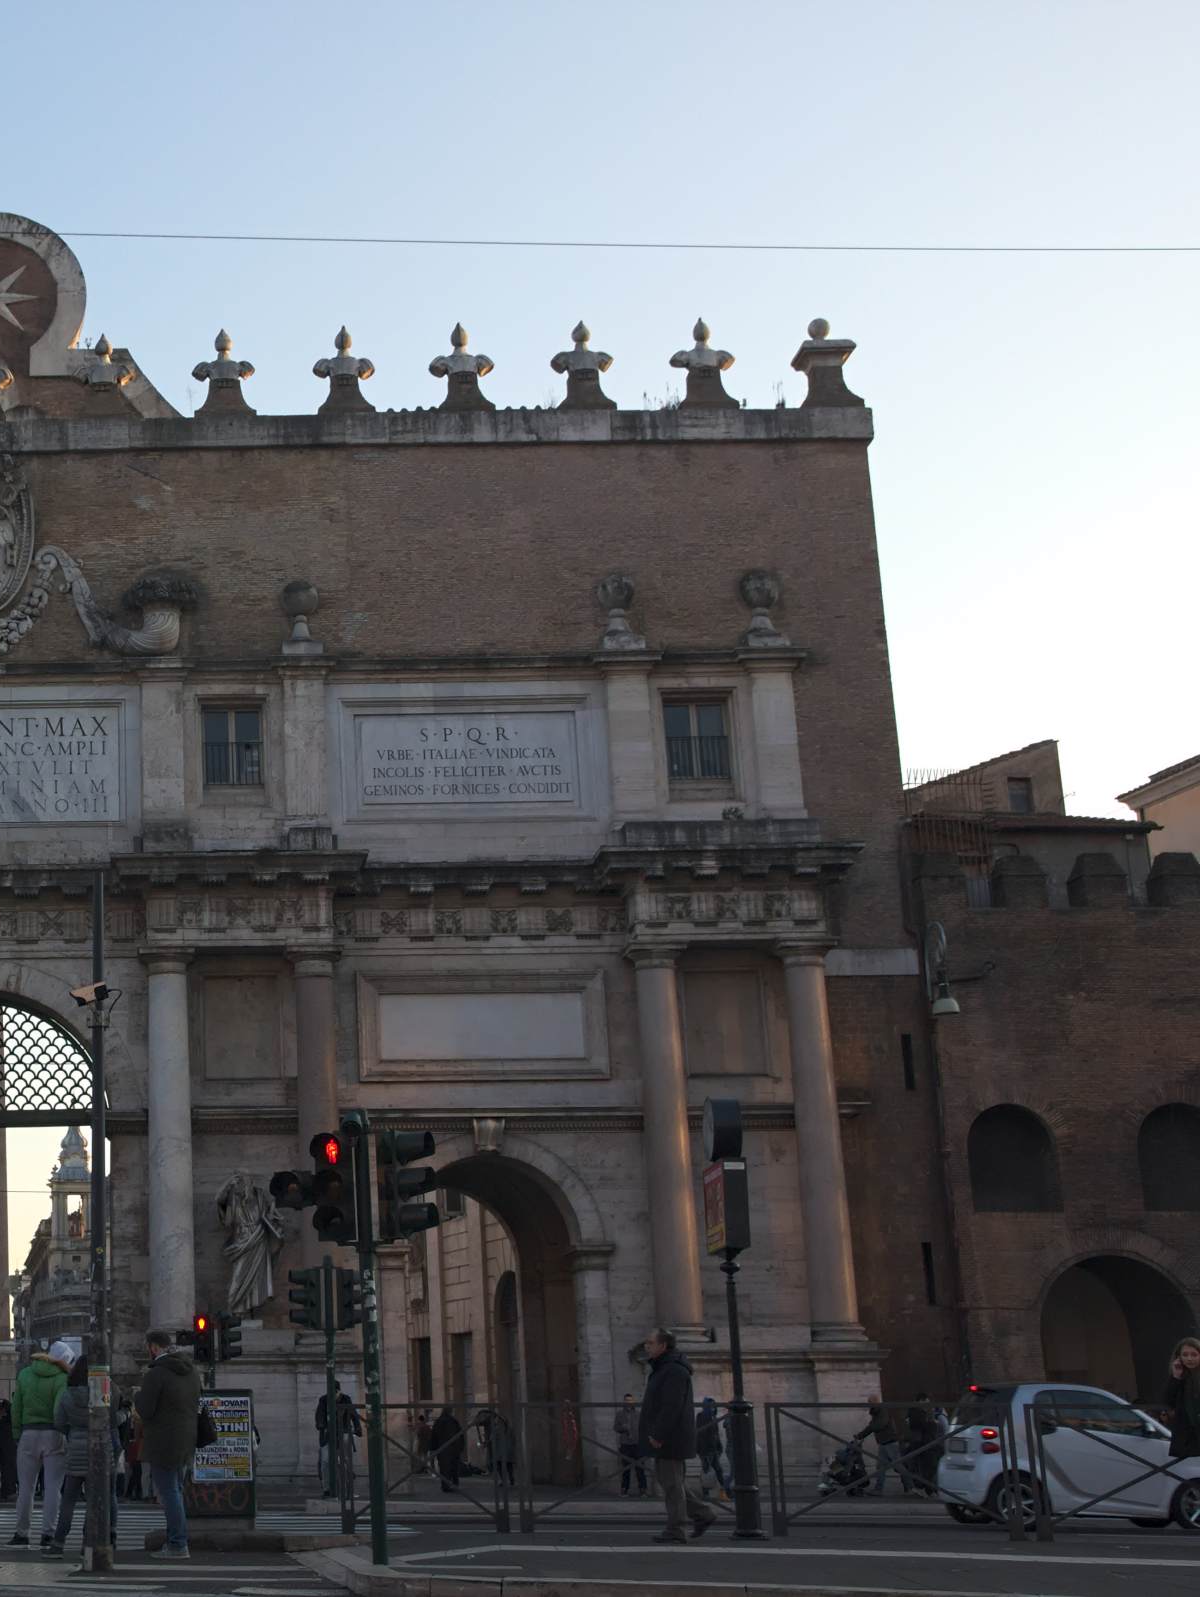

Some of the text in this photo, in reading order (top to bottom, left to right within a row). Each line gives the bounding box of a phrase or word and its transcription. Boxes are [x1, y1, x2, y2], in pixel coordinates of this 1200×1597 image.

[44, 716, 108, 737] MAX
[43, 740, 107, 756] AMPLI
[377, 747, 557, 762] VRBE ITALIAE VINDICATA
[372, 764, 562, 779] INCOLIS FELICITER AVCTIS
[363, 782, 572, 797] GEMINOS FORNICES CONDIDIT
[82, 796, 108, 813] III
